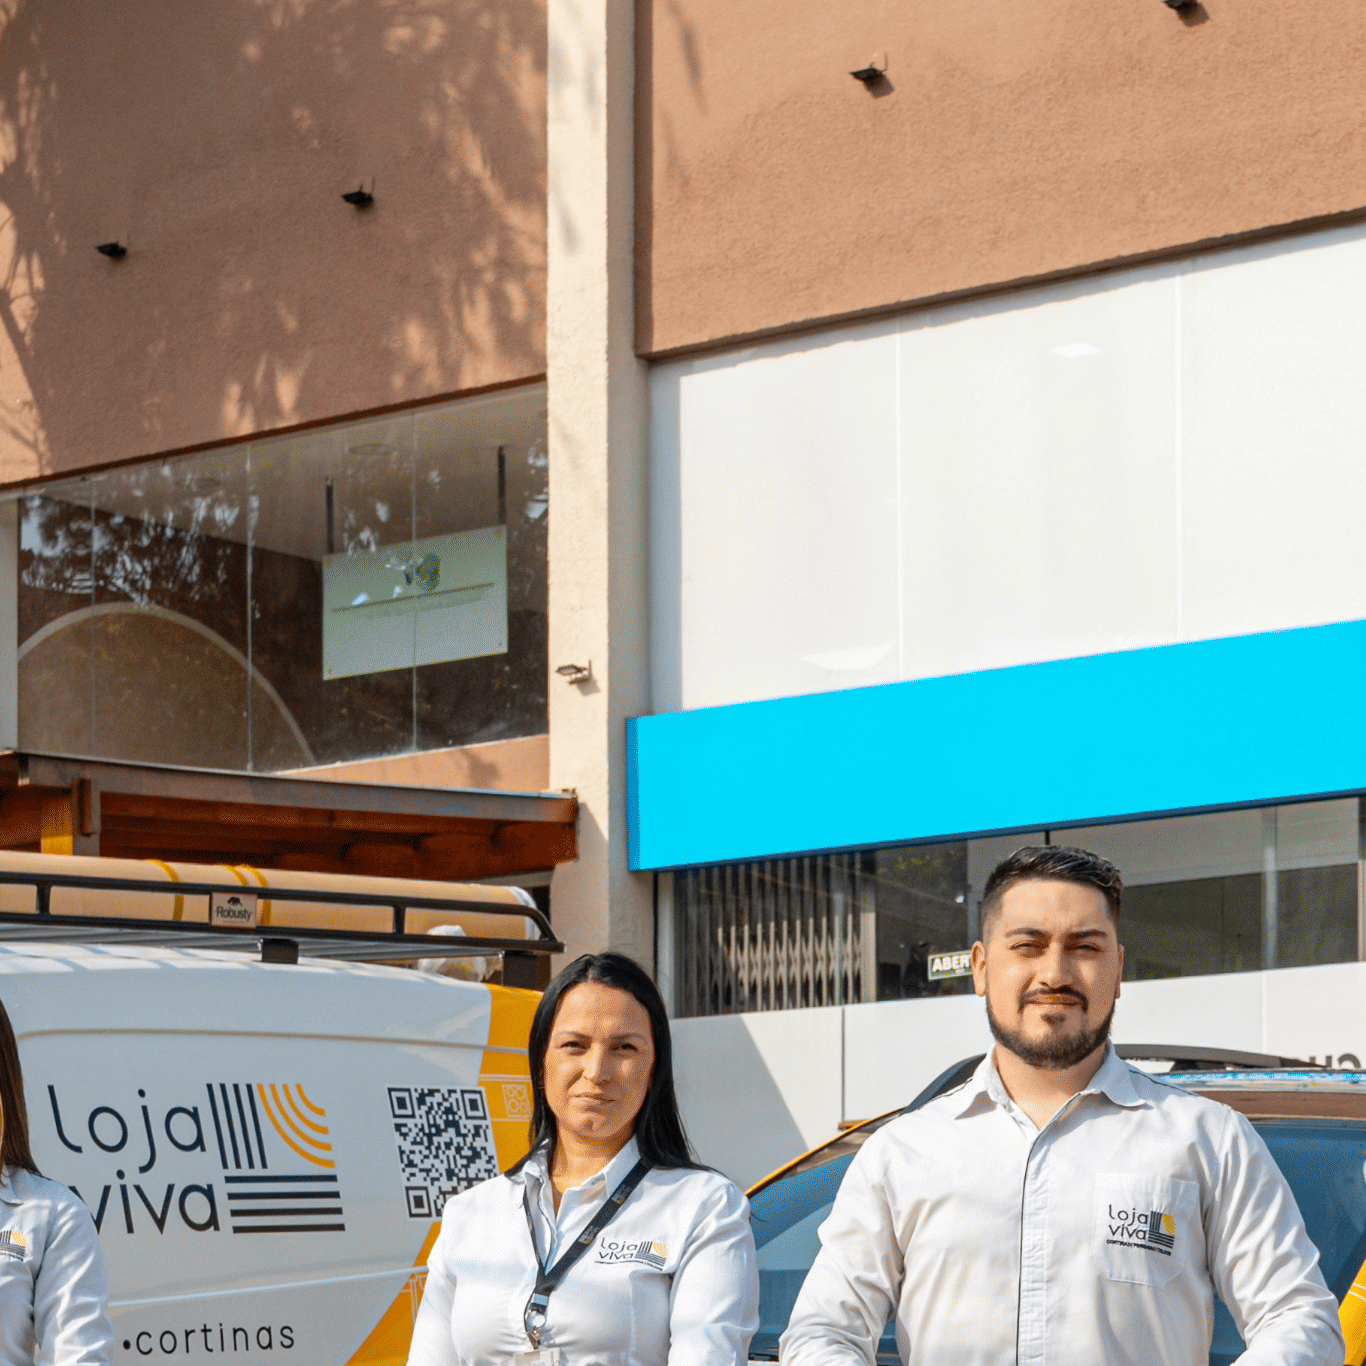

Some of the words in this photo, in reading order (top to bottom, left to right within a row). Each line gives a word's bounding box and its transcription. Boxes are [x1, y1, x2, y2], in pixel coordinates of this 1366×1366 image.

[932, 954, 972, 972] ABER
[47, 1084, 206, 1174] loja
[1109, 1204, 1149, 1227] loja
[1108, 1224, 1148, 1241] viva
[600, 1237, 638, 1254] loja
[598, 1251, 635, 1260] viva
[136, 1323, 296, 1356] cortinas
